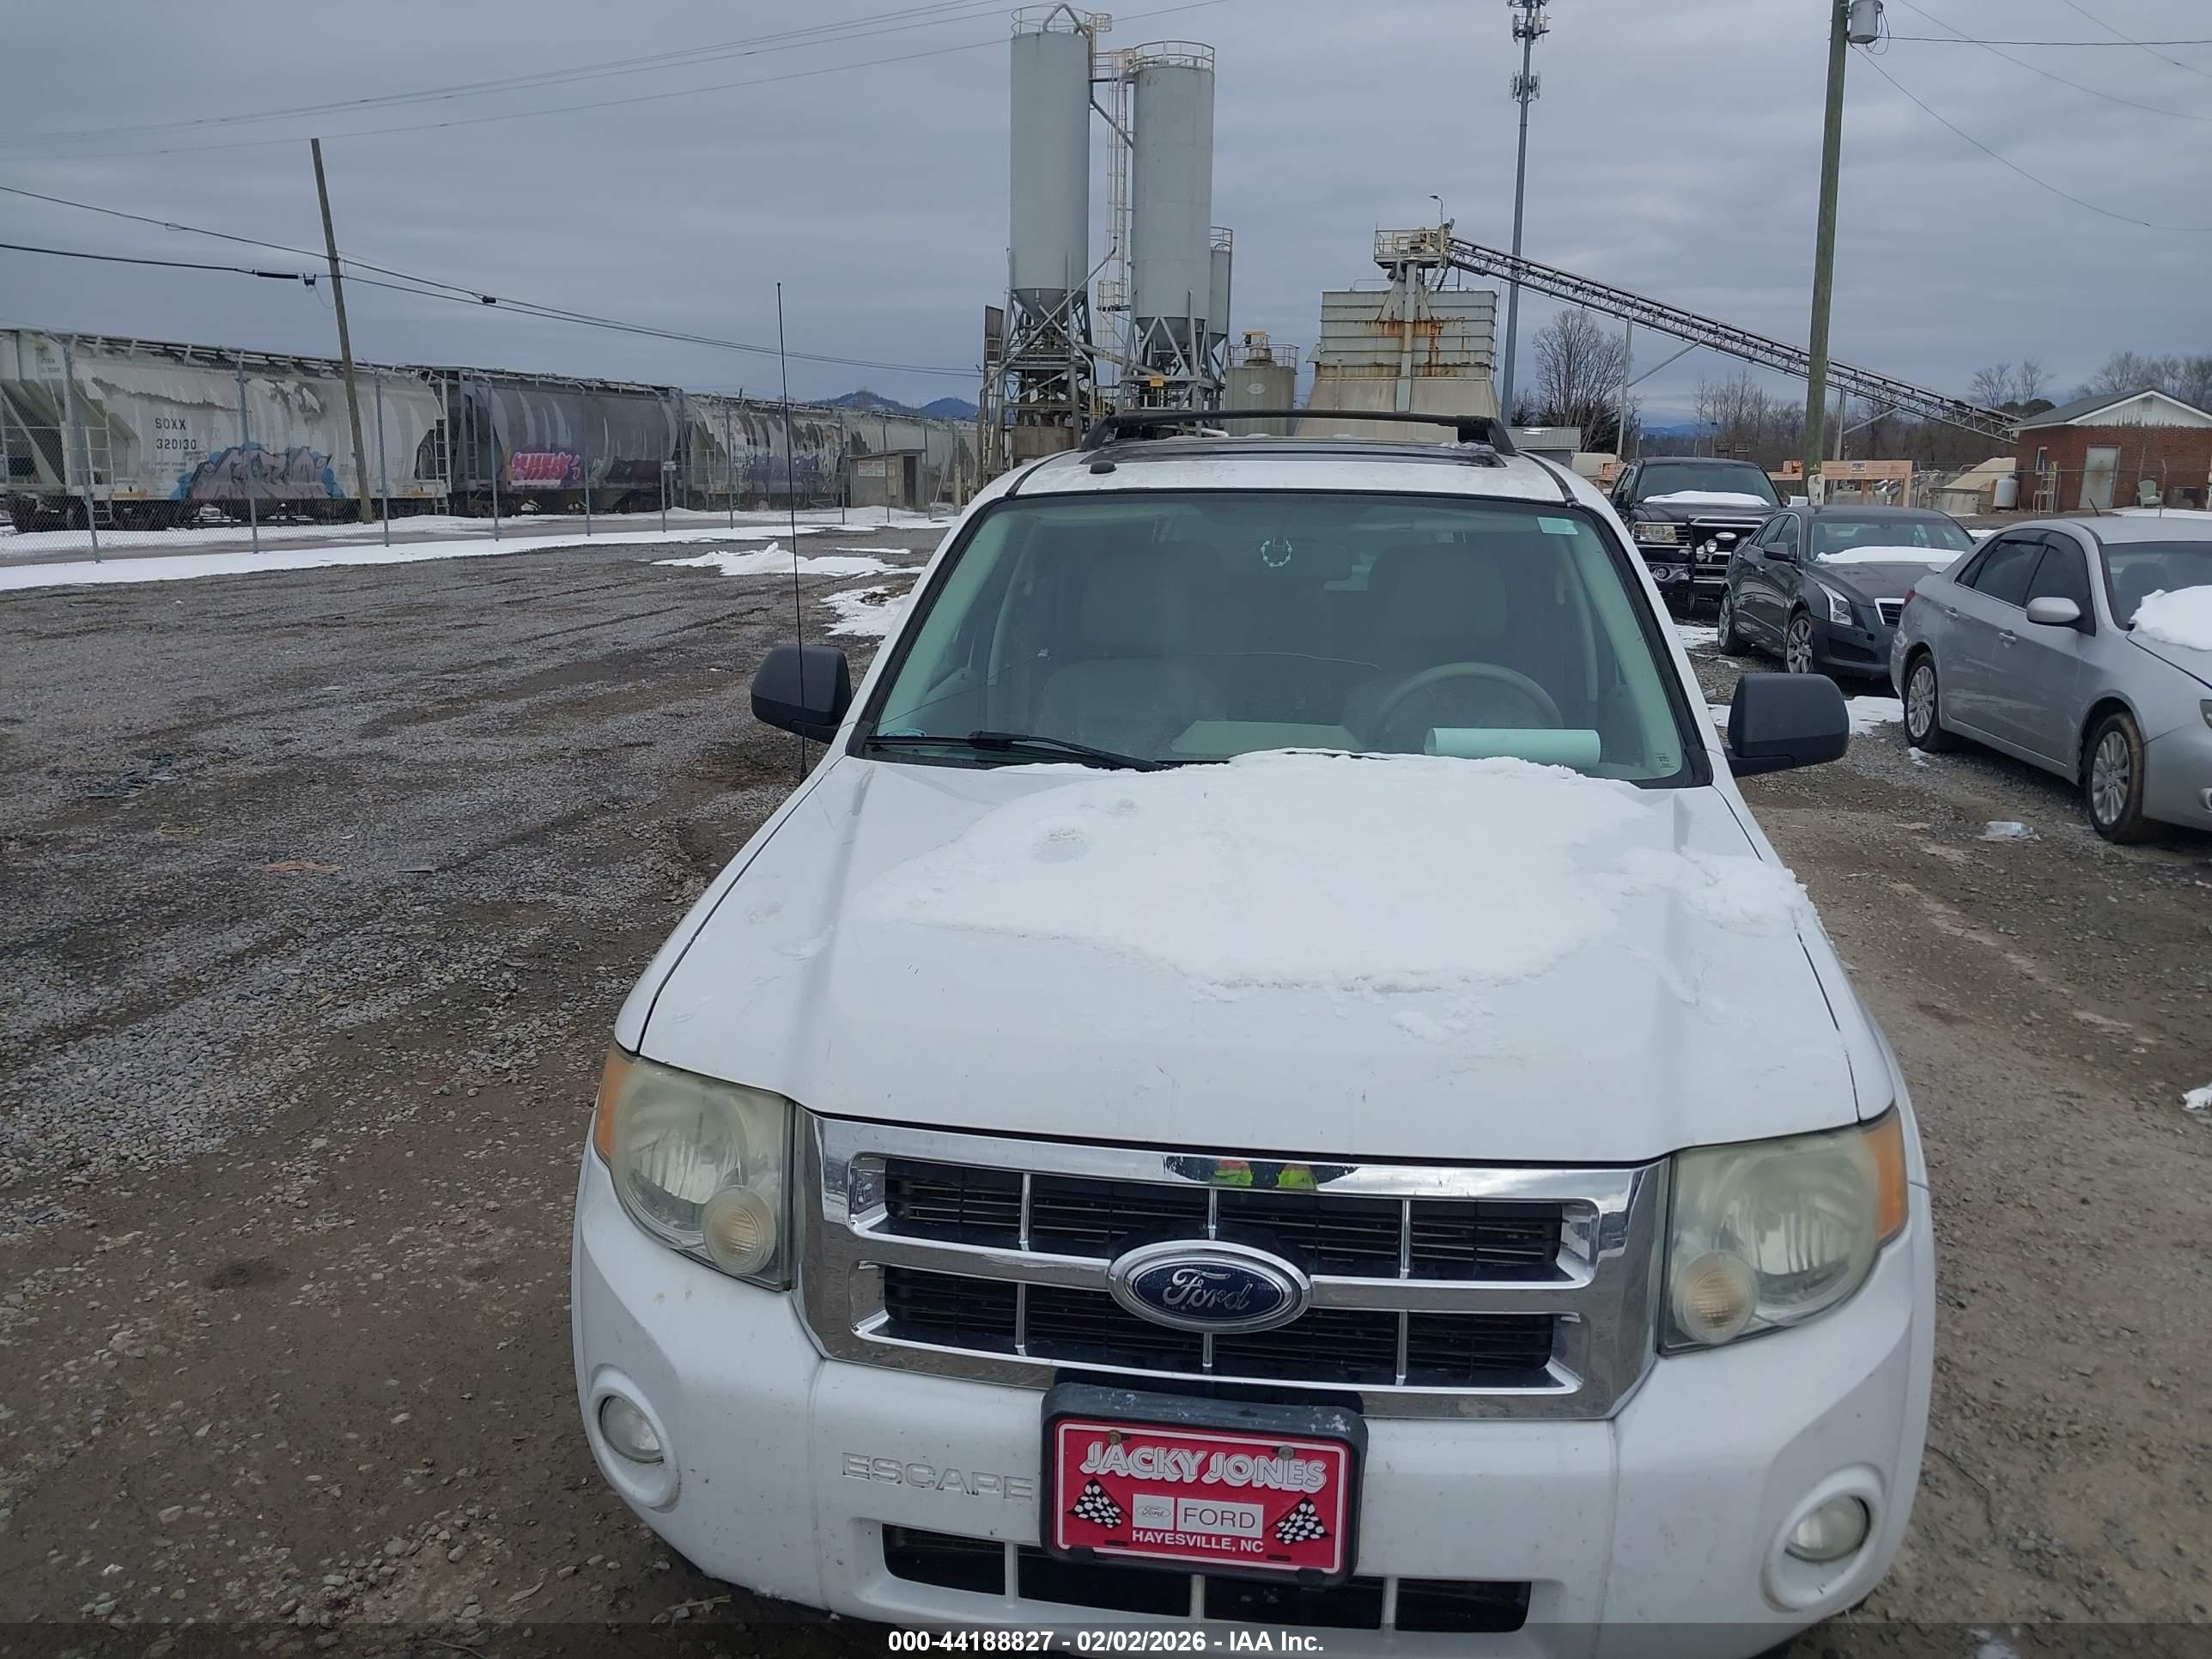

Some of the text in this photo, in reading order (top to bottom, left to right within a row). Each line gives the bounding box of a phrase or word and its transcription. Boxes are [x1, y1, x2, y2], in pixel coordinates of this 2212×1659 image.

[156, 438, 197, 450] 320130
[1162, 1268, 1254, 1311] Ford
[841, 1452, 1034, 1503] ESCAPE
[1079, 1441, 1328, 1493] JACKY JONES
[1141, 1505, 1165, 1517] Ford
[1182, 1506, 1257, 1529] FORD
[1132, 1530, 1264, 1553] HAYESVILLE, NC
